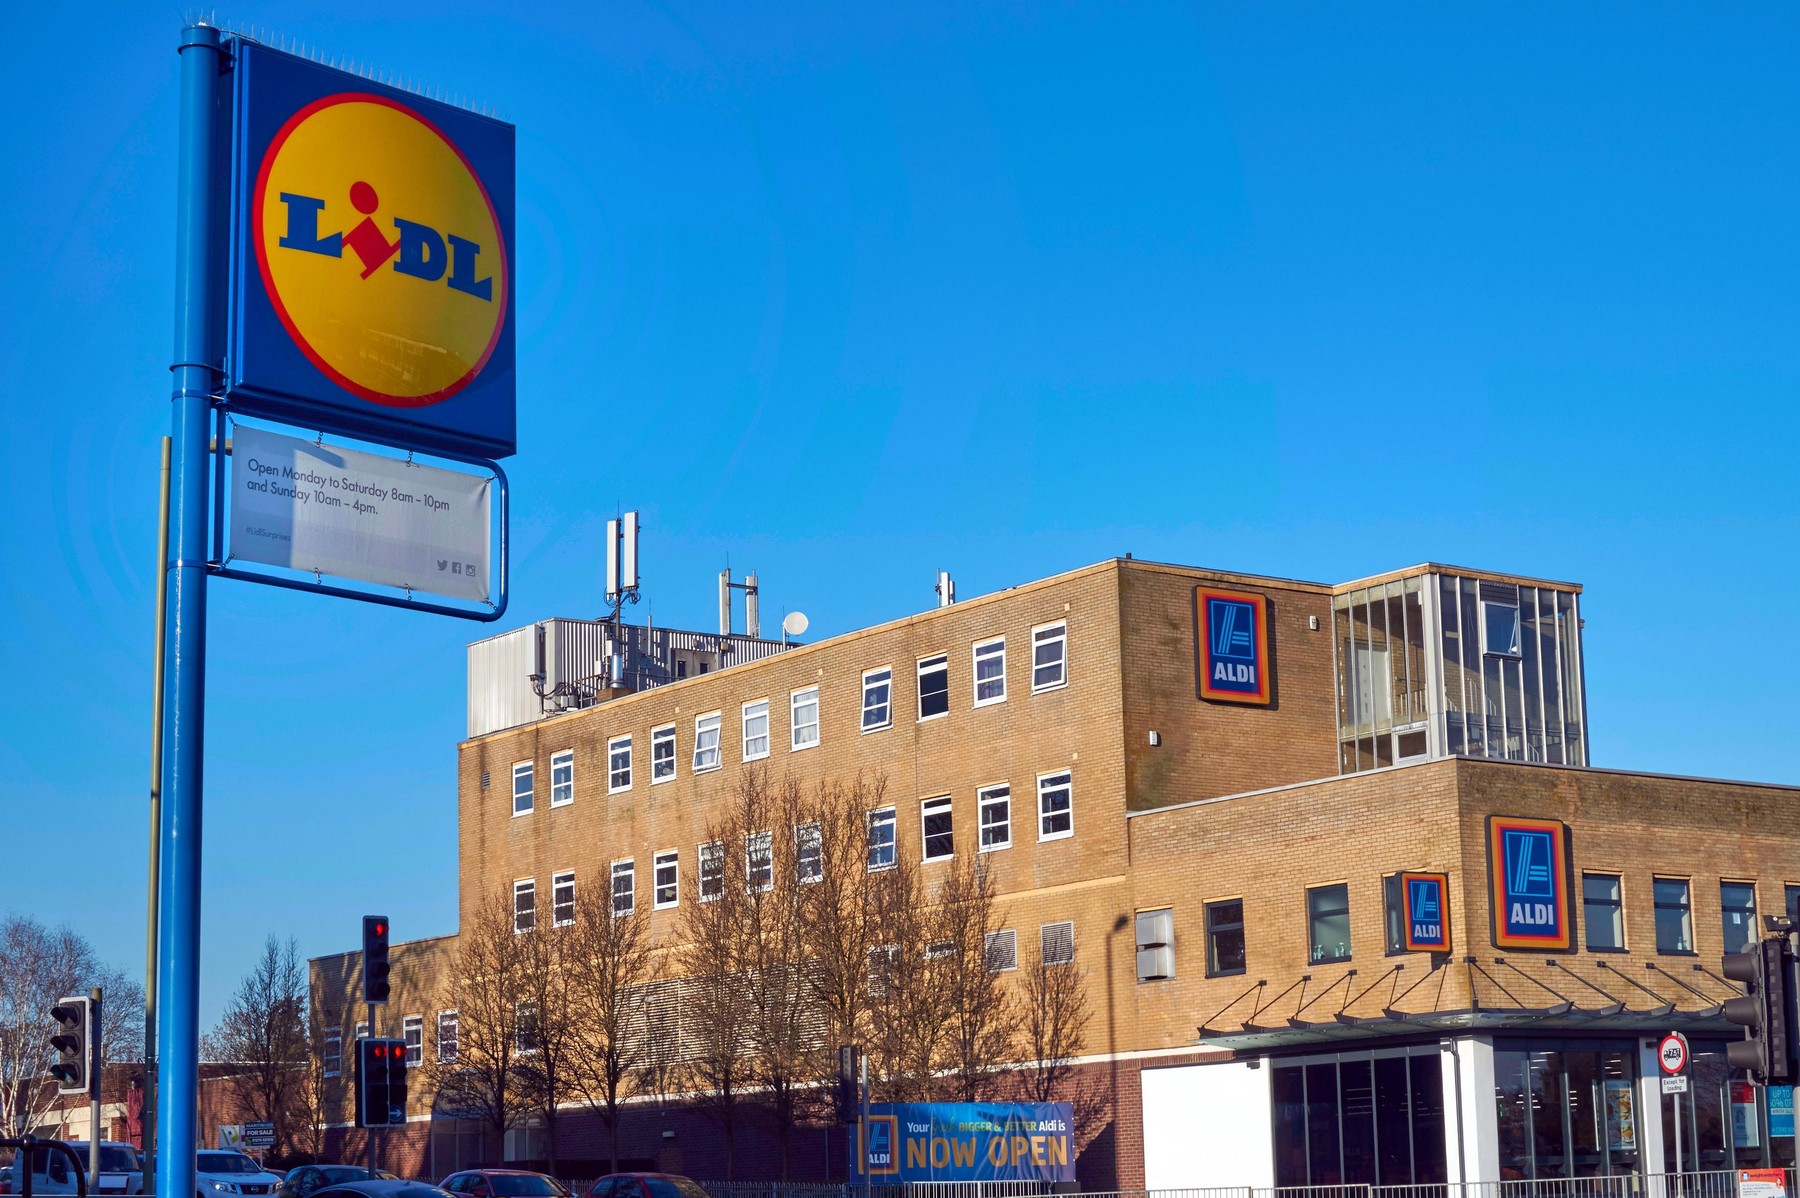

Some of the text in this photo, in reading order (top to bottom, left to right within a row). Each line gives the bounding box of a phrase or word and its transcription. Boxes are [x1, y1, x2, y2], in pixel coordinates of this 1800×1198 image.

[248, 458, 279, 476] Open
[282, 466, 327, 488] Monday
[329, 477, 340, 488] to
[342, 477, 389, 501] Saturday
[391, 488, 414, 503] 8am
[424, 494, 450, 512] 10pm
[247, 480, 268, 493] and
[270, 481, 310, 504] Sunday
[314, 490, 341, 507] 10am
[352, 499, 378, 515] 4pm.
[1214, 662, 1255, 684] ALDI
[1511, 902, 1554, 925] ALDI
[1414, 924, 1441, 938] ALDI
[907, 1122, 930, 1132] Your
[959, 1121, 992, 1132] BIGGER
[994, 1122, 1002, 1132] &
[1004, 1121, 1036, 1132] BETTER
[1039, 1120, 1057, 1131] Aldi
[1058, 1120, 1066, 1131] is
[869, 1153, 890, 1164] ALDI
[906, 1135, 1068, 1168] NOW OPEN
